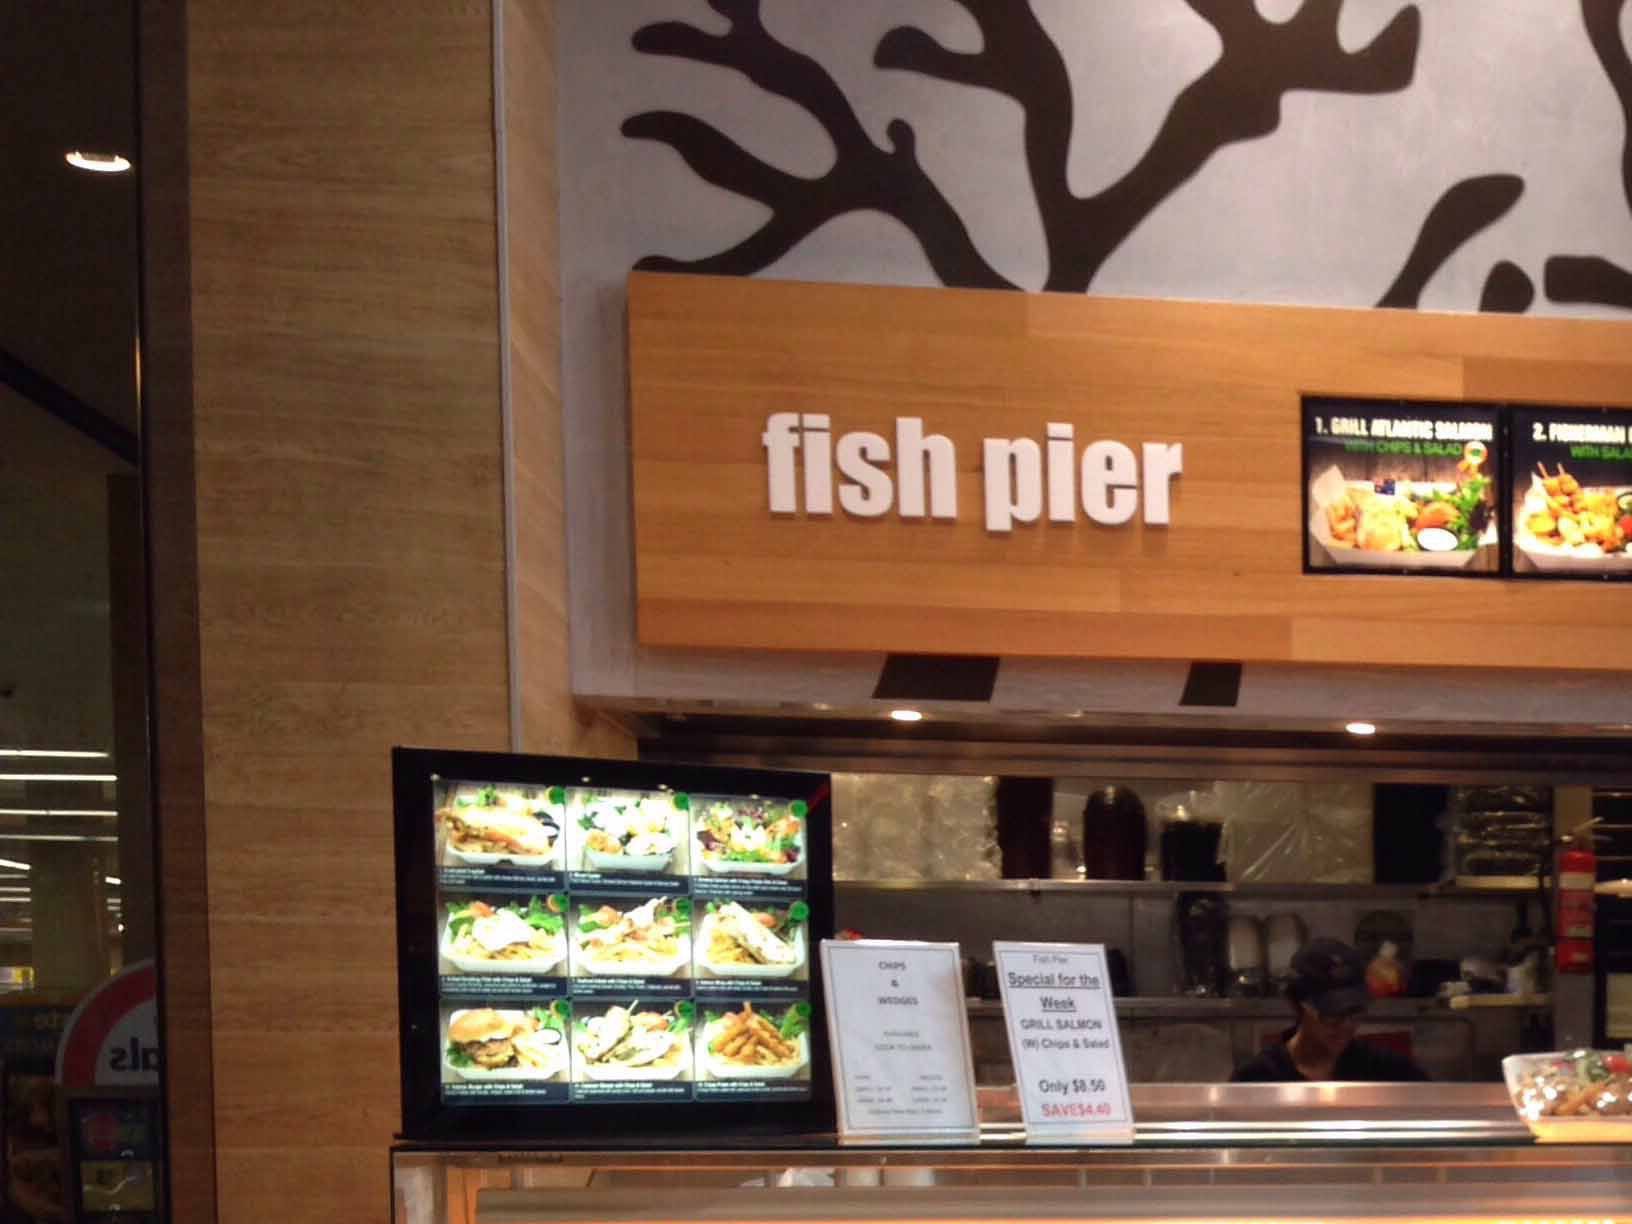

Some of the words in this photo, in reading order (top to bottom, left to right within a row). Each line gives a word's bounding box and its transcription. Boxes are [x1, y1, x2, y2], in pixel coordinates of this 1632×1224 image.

[1330, 416, 1368, 436] GRILL
[762, 412, 958, 518] fish
[984, 422, 1183, 532] pier
[878, 961, 906, 971] CHIPS
[1008, 972, 1054, 986] Special
[1058, 973, 1076, 985] for
[1080, 973, 1099, 985] the
[877, 996, 919, 1006] WEDGES
[1040, 996, 1075, 1009] Week
[1020, 1019, 1051, 1030] GRILL
[1056, 1019, 1103, 1030] SALMON
[1041, 1038, 1070, 1050] Chips
[1073, 1040, 1080, 1049] &
[1039, 1079, 1068, 1095] Only
